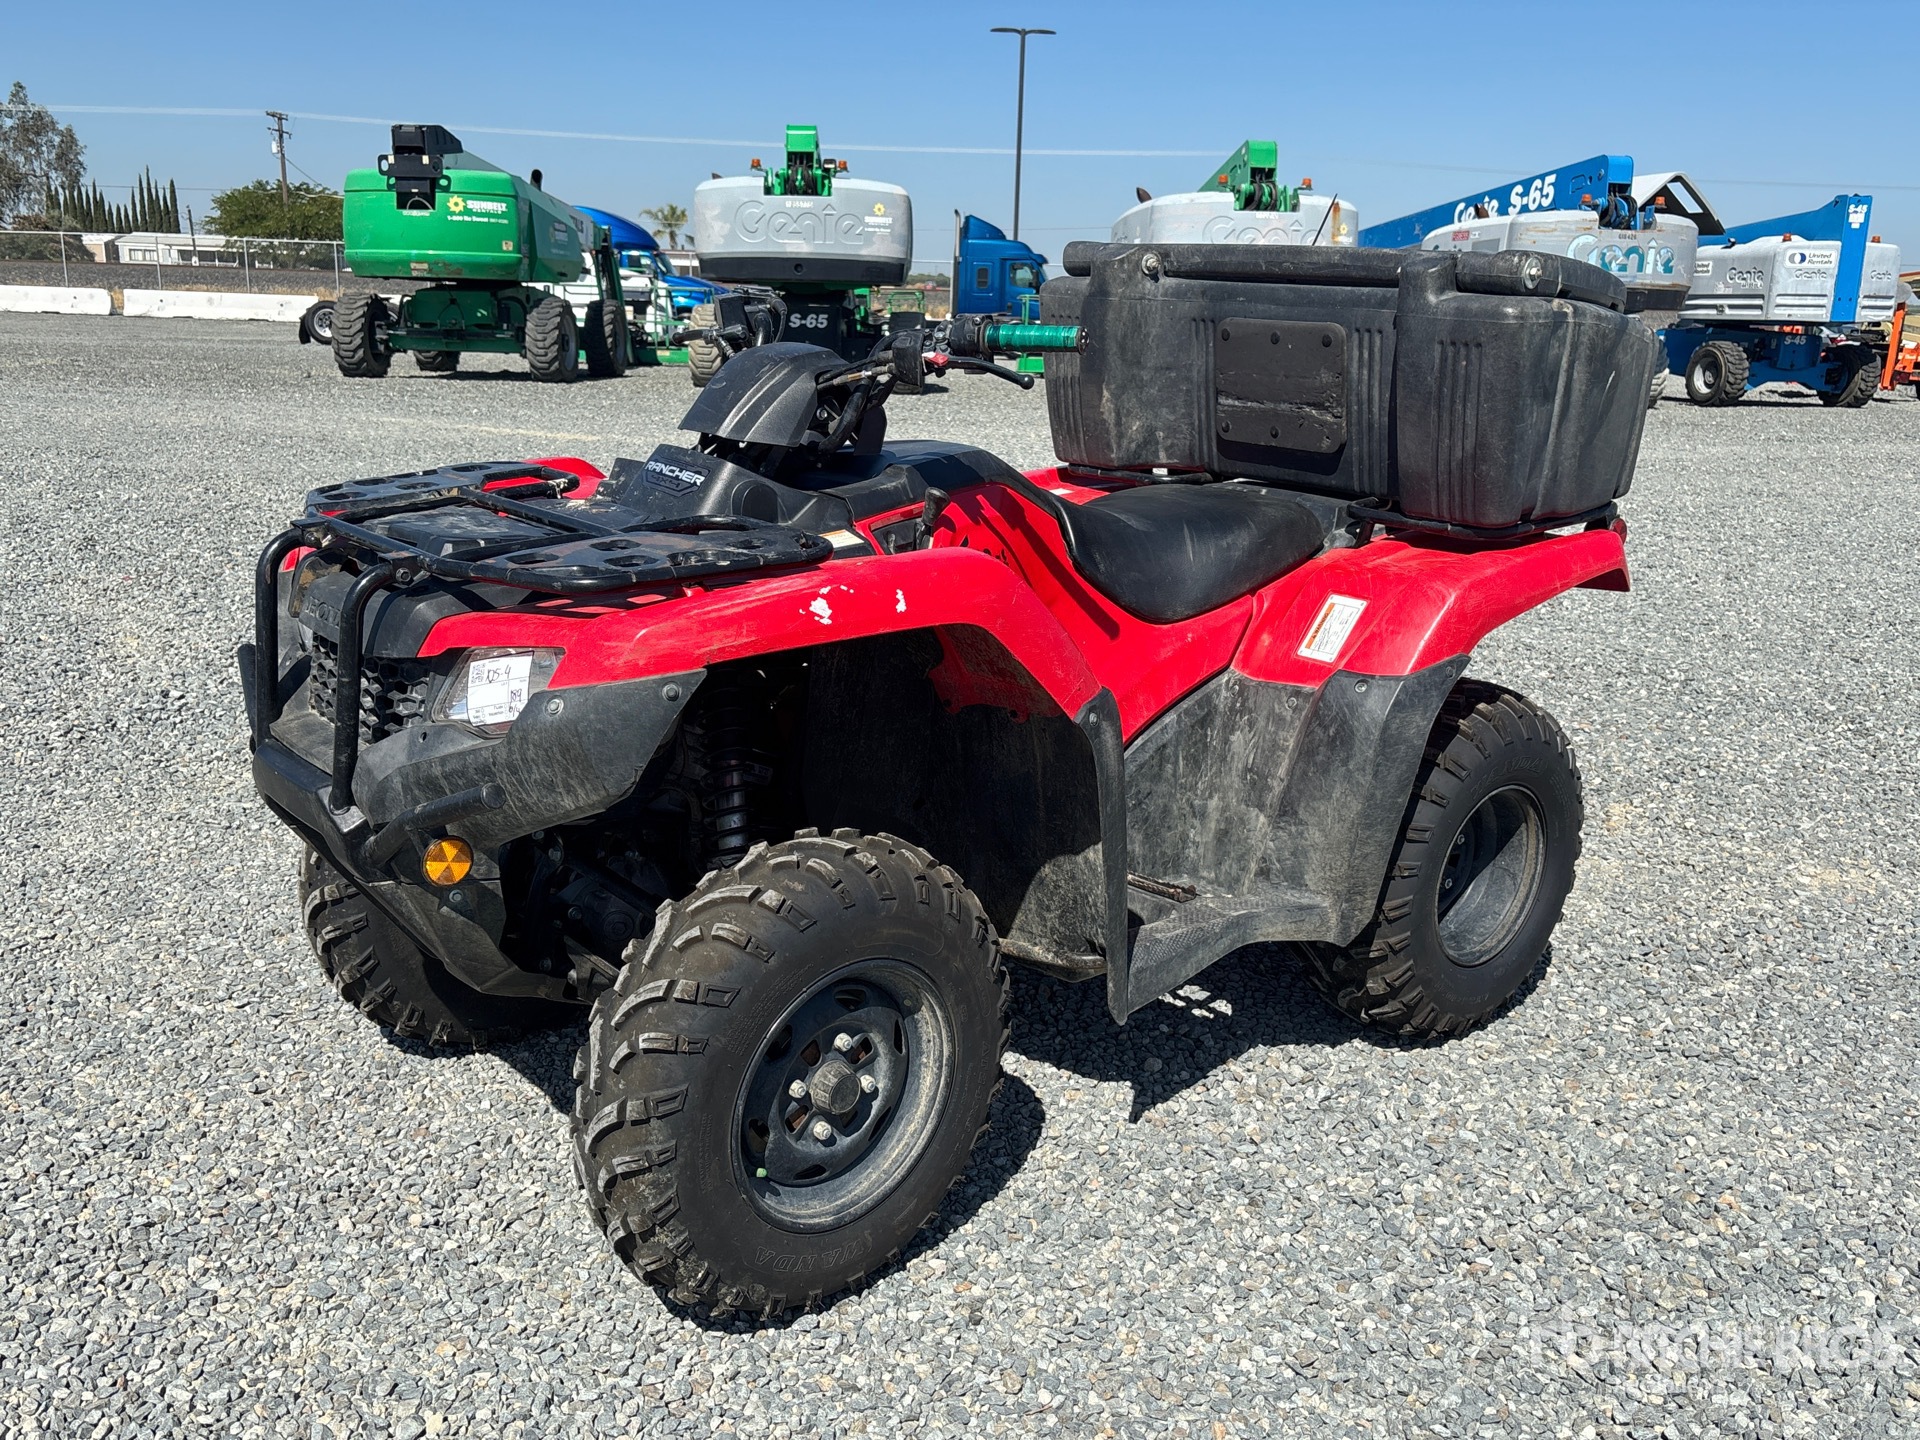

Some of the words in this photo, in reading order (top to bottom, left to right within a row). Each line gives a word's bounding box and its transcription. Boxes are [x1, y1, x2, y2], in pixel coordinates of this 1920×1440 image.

[466, 200, 508, 212] SUNBELT
[1454, 195, 1499, 225] Geie
[1508, 173, 1557, 216] S-65
[1847, 204, 1868, 214] S-45
[734, 200, 864, 244] Genie
[1566, 234, 1675, 275] Genie
[1727, 266, 1764, 284] Genie
[1794, 268, 1828, 281] Genie
[788, 313, 829, 328] S-65
[1784, 335, 1807, 345] S-45
[644, 460, 706, 487] RANCHER
